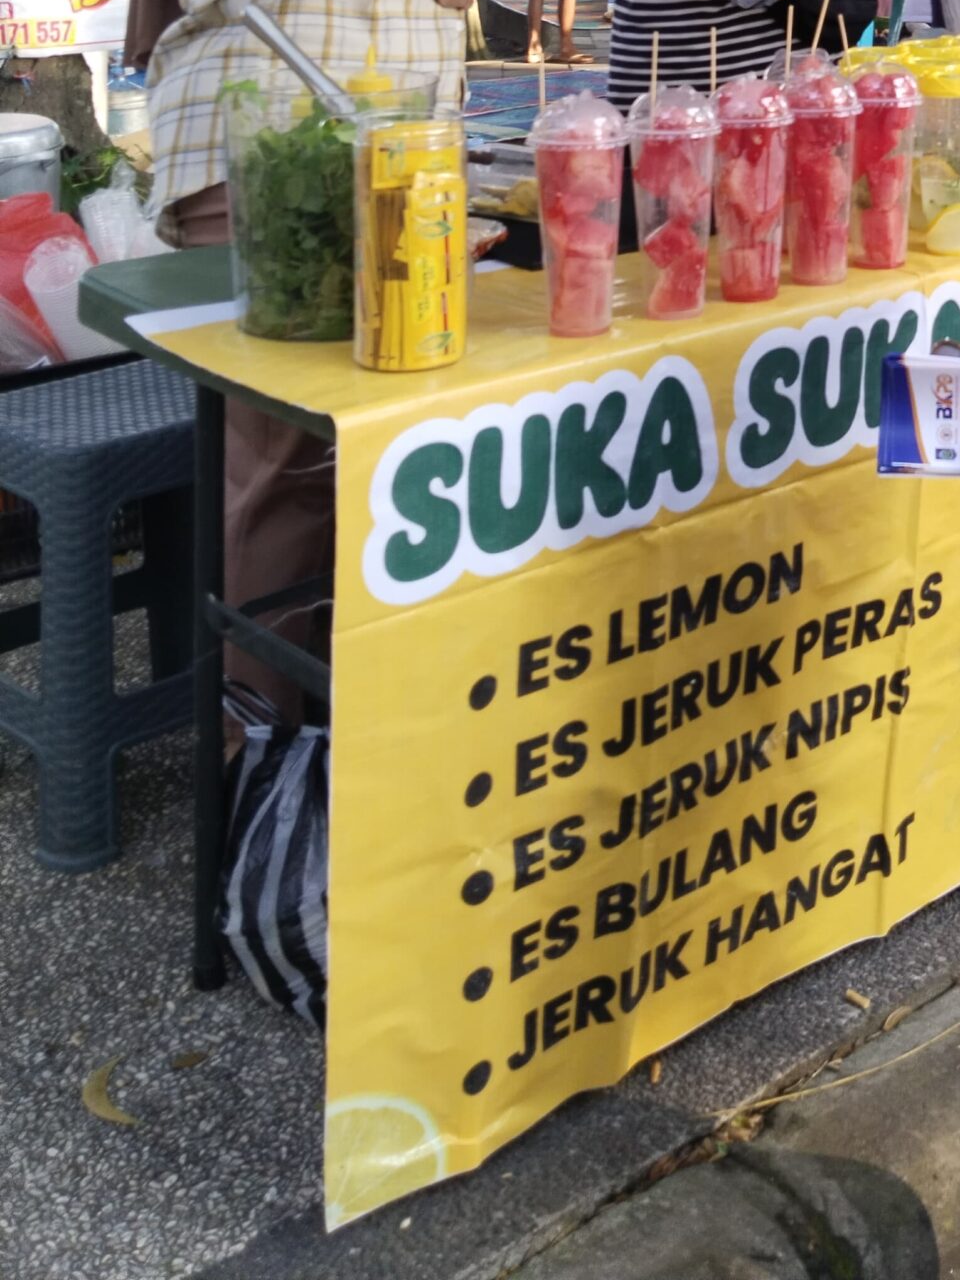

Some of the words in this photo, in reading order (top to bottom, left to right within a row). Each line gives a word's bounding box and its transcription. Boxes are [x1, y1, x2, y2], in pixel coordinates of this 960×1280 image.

[37, 20, 73, 44] 557
[384, 376, 703, 583] SUKA
[514, 719, 589, 796] ES
[602, 638, 784, 758] JERUK
[792, 572, 944, 675] PERAS
[516, 624, 593, 697] ES
[606, 542, 804, 665] LEMON
[513, 813, 586, 892] ES
[599, 721, 776, 850] JERUK
[785, 666, 911, 761] NIPIS
[507, 931, 694, 1070] JERUK
[703, 812, 916, 966] HANGAT
[510, 906, 580, 983] ES
[593, 790, 819, 940] BULANG
